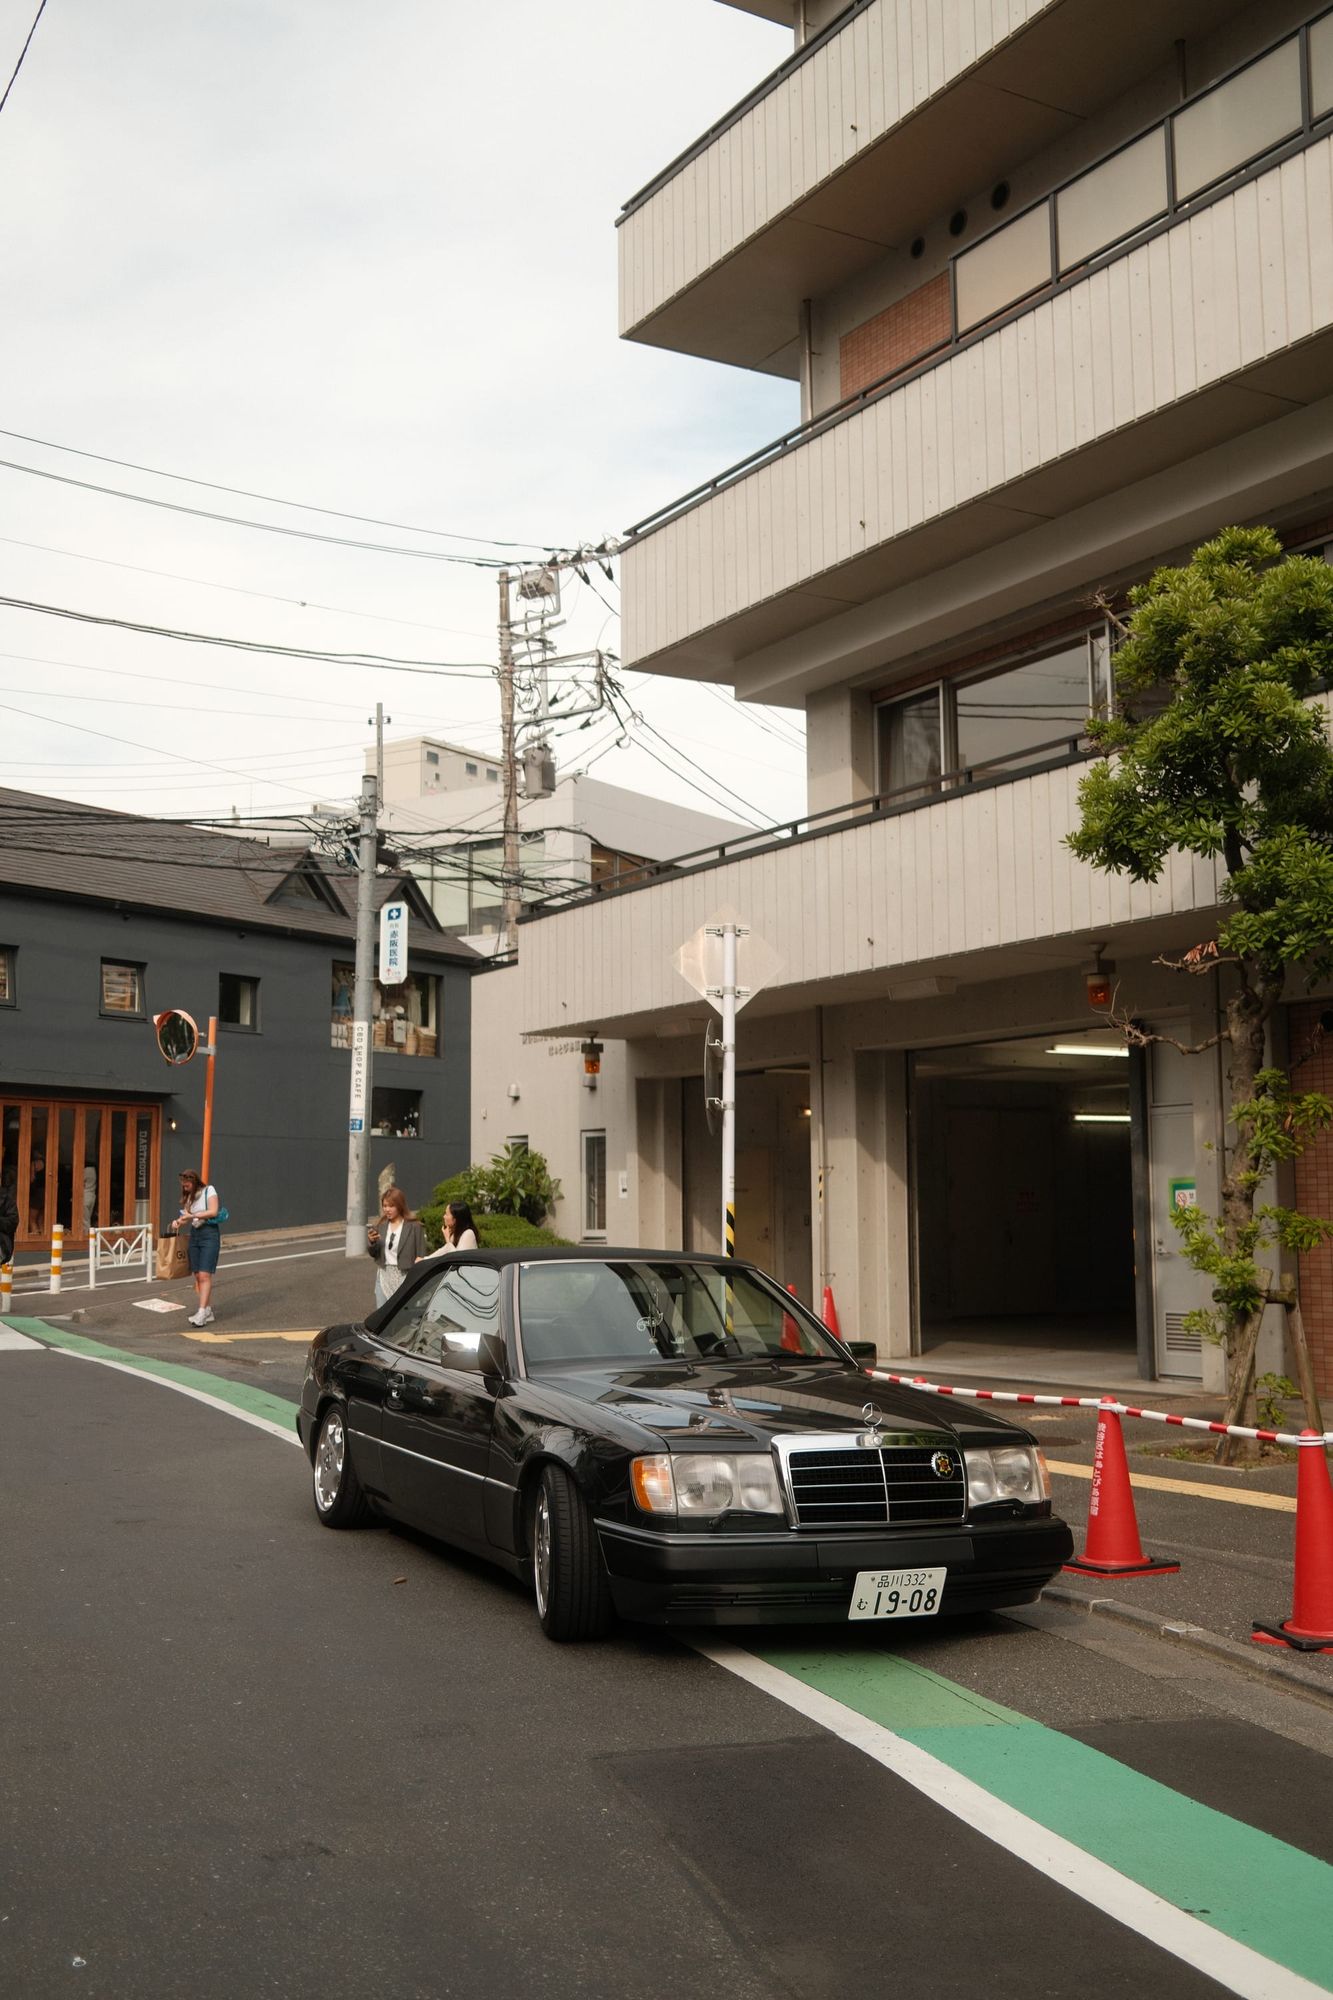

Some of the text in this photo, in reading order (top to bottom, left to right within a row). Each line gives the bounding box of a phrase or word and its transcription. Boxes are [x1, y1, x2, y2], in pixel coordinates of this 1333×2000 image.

[356, 1026, 364, 1043] CBD
[355, 1045, 363, 1068] SHOP
[354, 1077, 362, 1099] CAFE
[138, 1130, 148, 1188] DARTMOUTH
[857, 1588, 938, 1615] む 19-08
